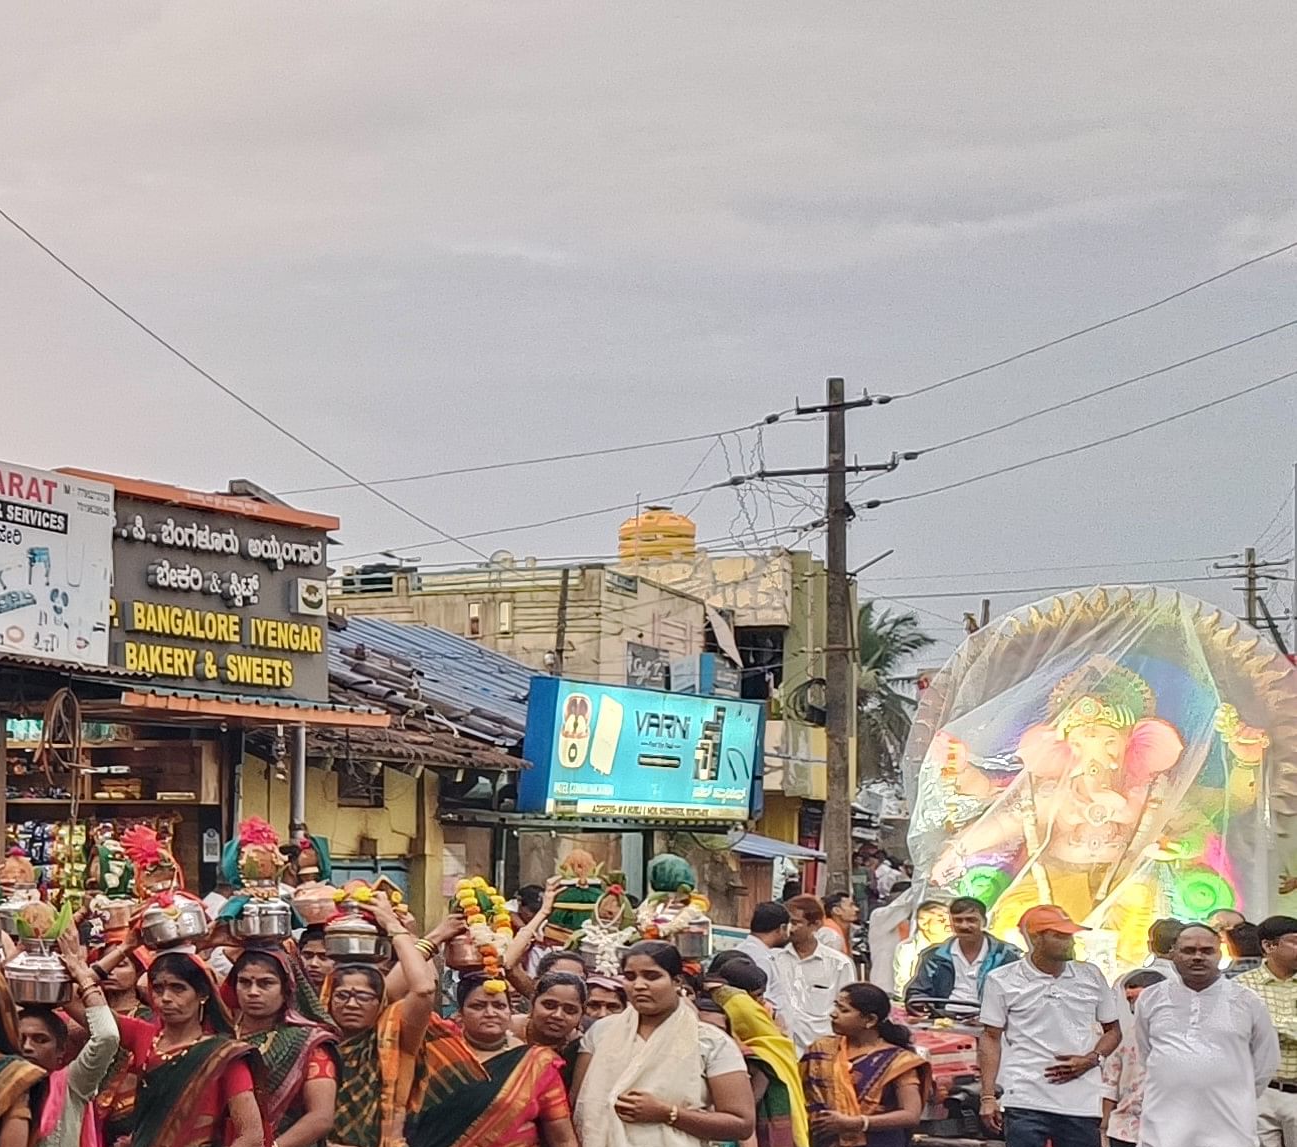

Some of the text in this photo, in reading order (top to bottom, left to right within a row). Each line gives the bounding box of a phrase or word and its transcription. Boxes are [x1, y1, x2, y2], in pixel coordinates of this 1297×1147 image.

[6, 504, 66, 531] SERVICES
[156, 560, 203, 591] ಬೇಕರಿ
[209, 572, 223, 594] &
[133, 600, 241, 643] BANGALORE
[250, 618, 323, 653] IYENGAR
[124, 641, 293, 688] BAKERY & SWEETS
